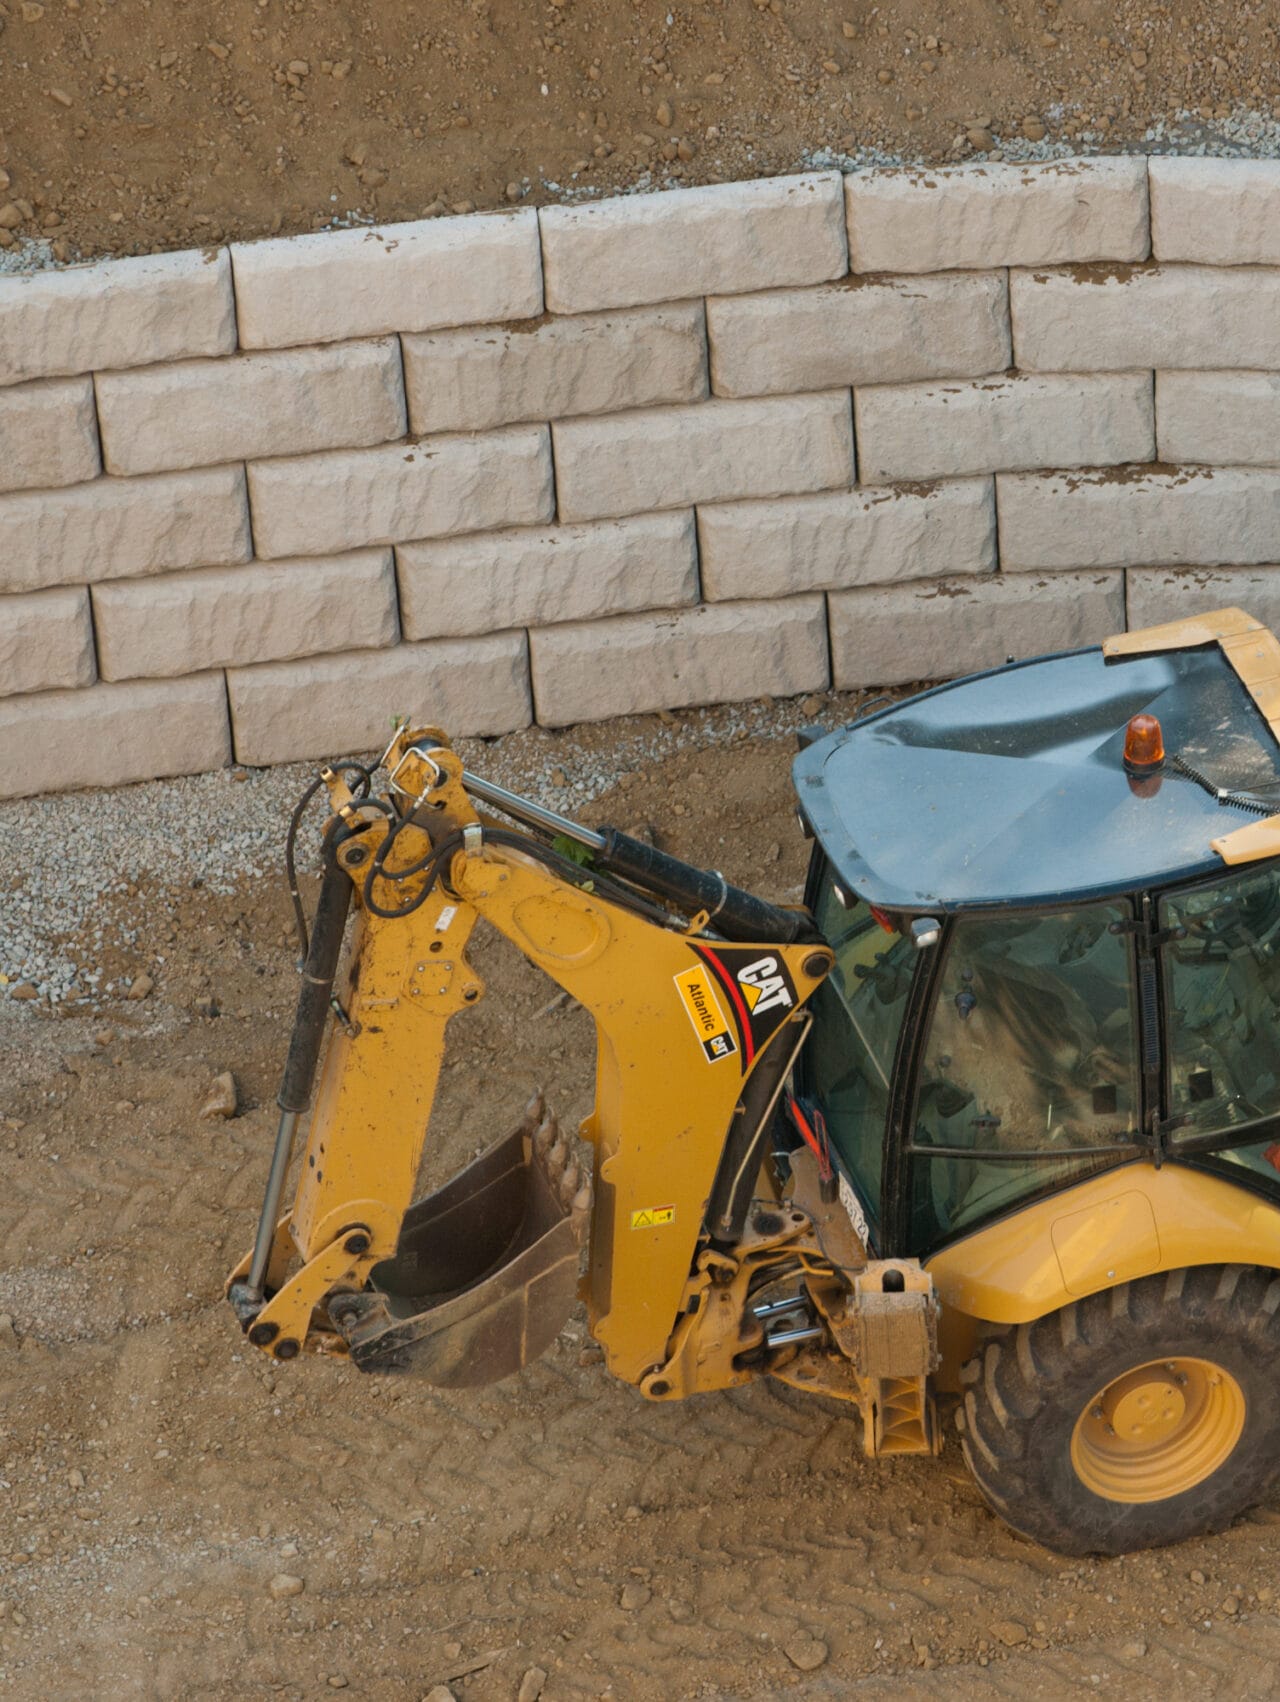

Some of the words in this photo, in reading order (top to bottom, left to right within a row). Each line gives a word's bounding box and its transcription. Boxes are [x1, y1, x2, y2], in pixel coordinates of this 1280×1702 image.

[688, 983, 715, 1032] Atlantic
[737, 956, 793, 1016] CAT
[710, 1035, 728, 1056] CAT
